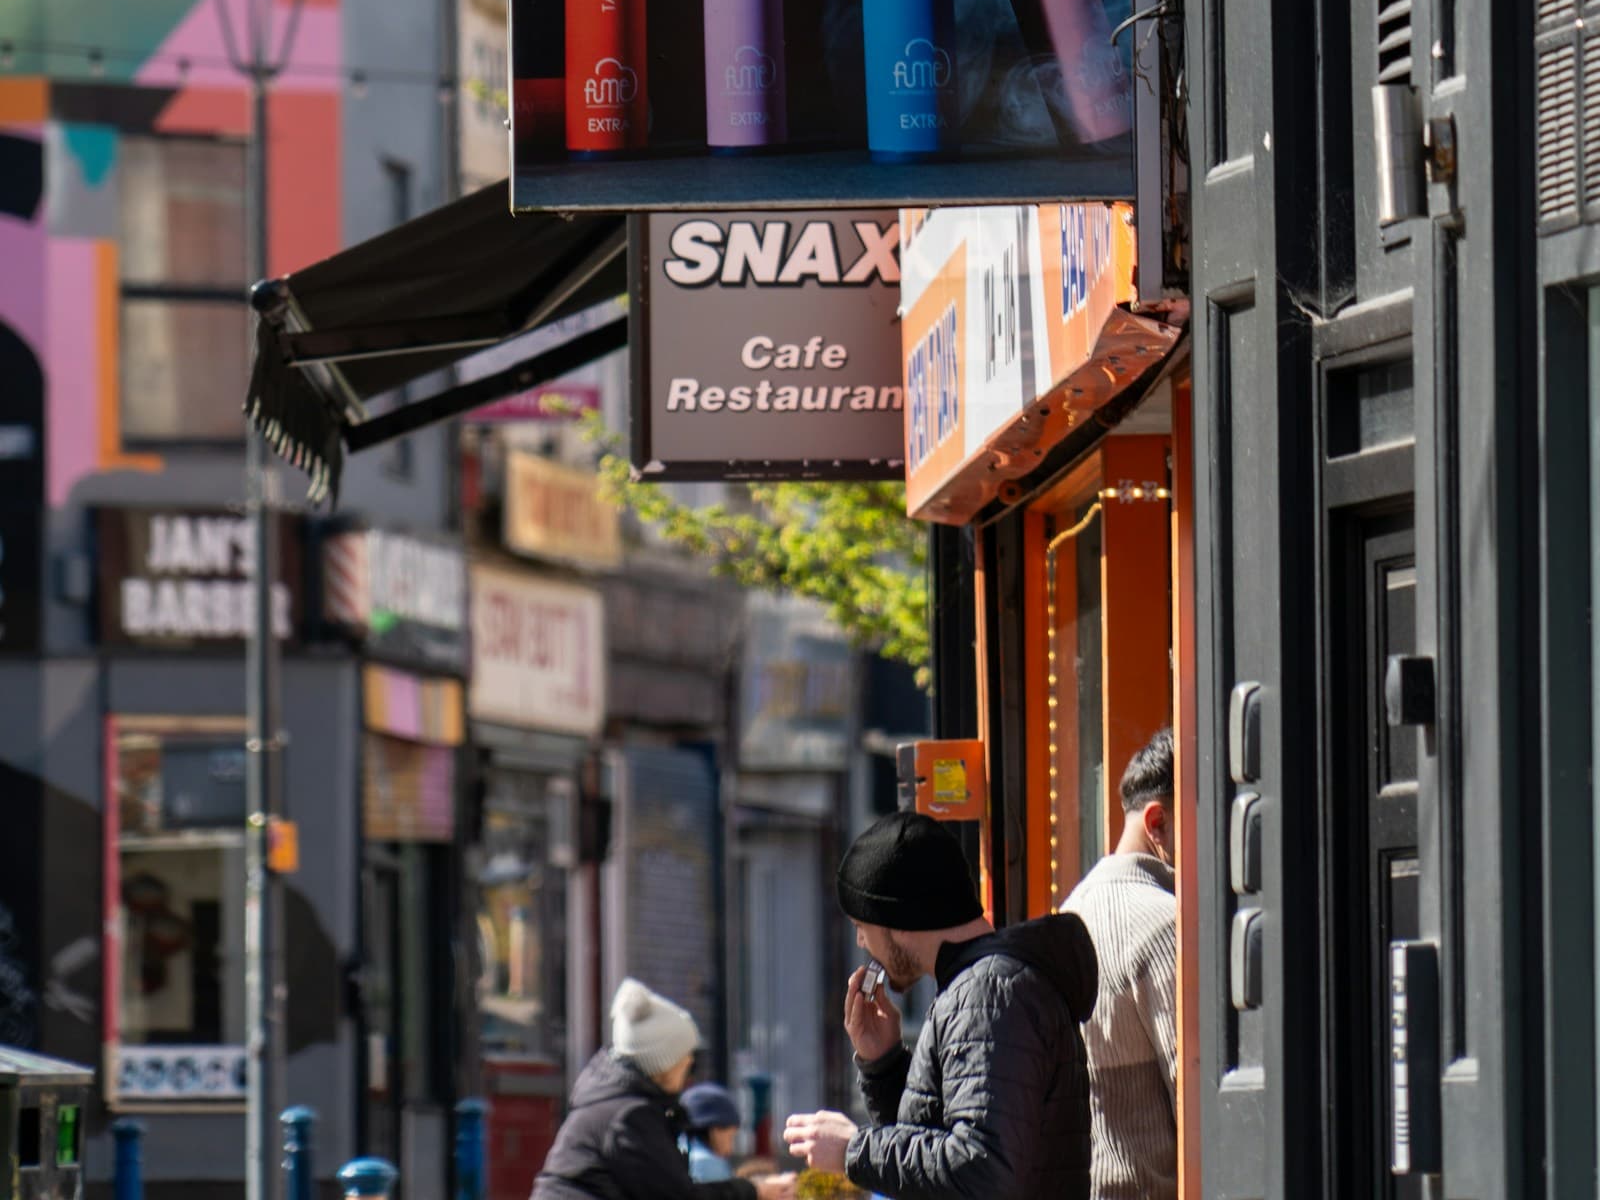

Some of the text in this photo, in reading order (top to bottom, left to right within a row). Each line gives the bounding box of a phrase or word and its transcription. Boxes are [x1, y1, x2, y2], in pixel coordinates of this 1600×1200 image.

[588, 118, 631, 133] EXTRA
[730, 111, 772, 127] EXTRA
[900, 113, 948, 129] EXTRA
[663, 219, 902, 289] SNAX
[740, 335, 848, 370] Cafe
[666, 378, 904, 412] Restauran
